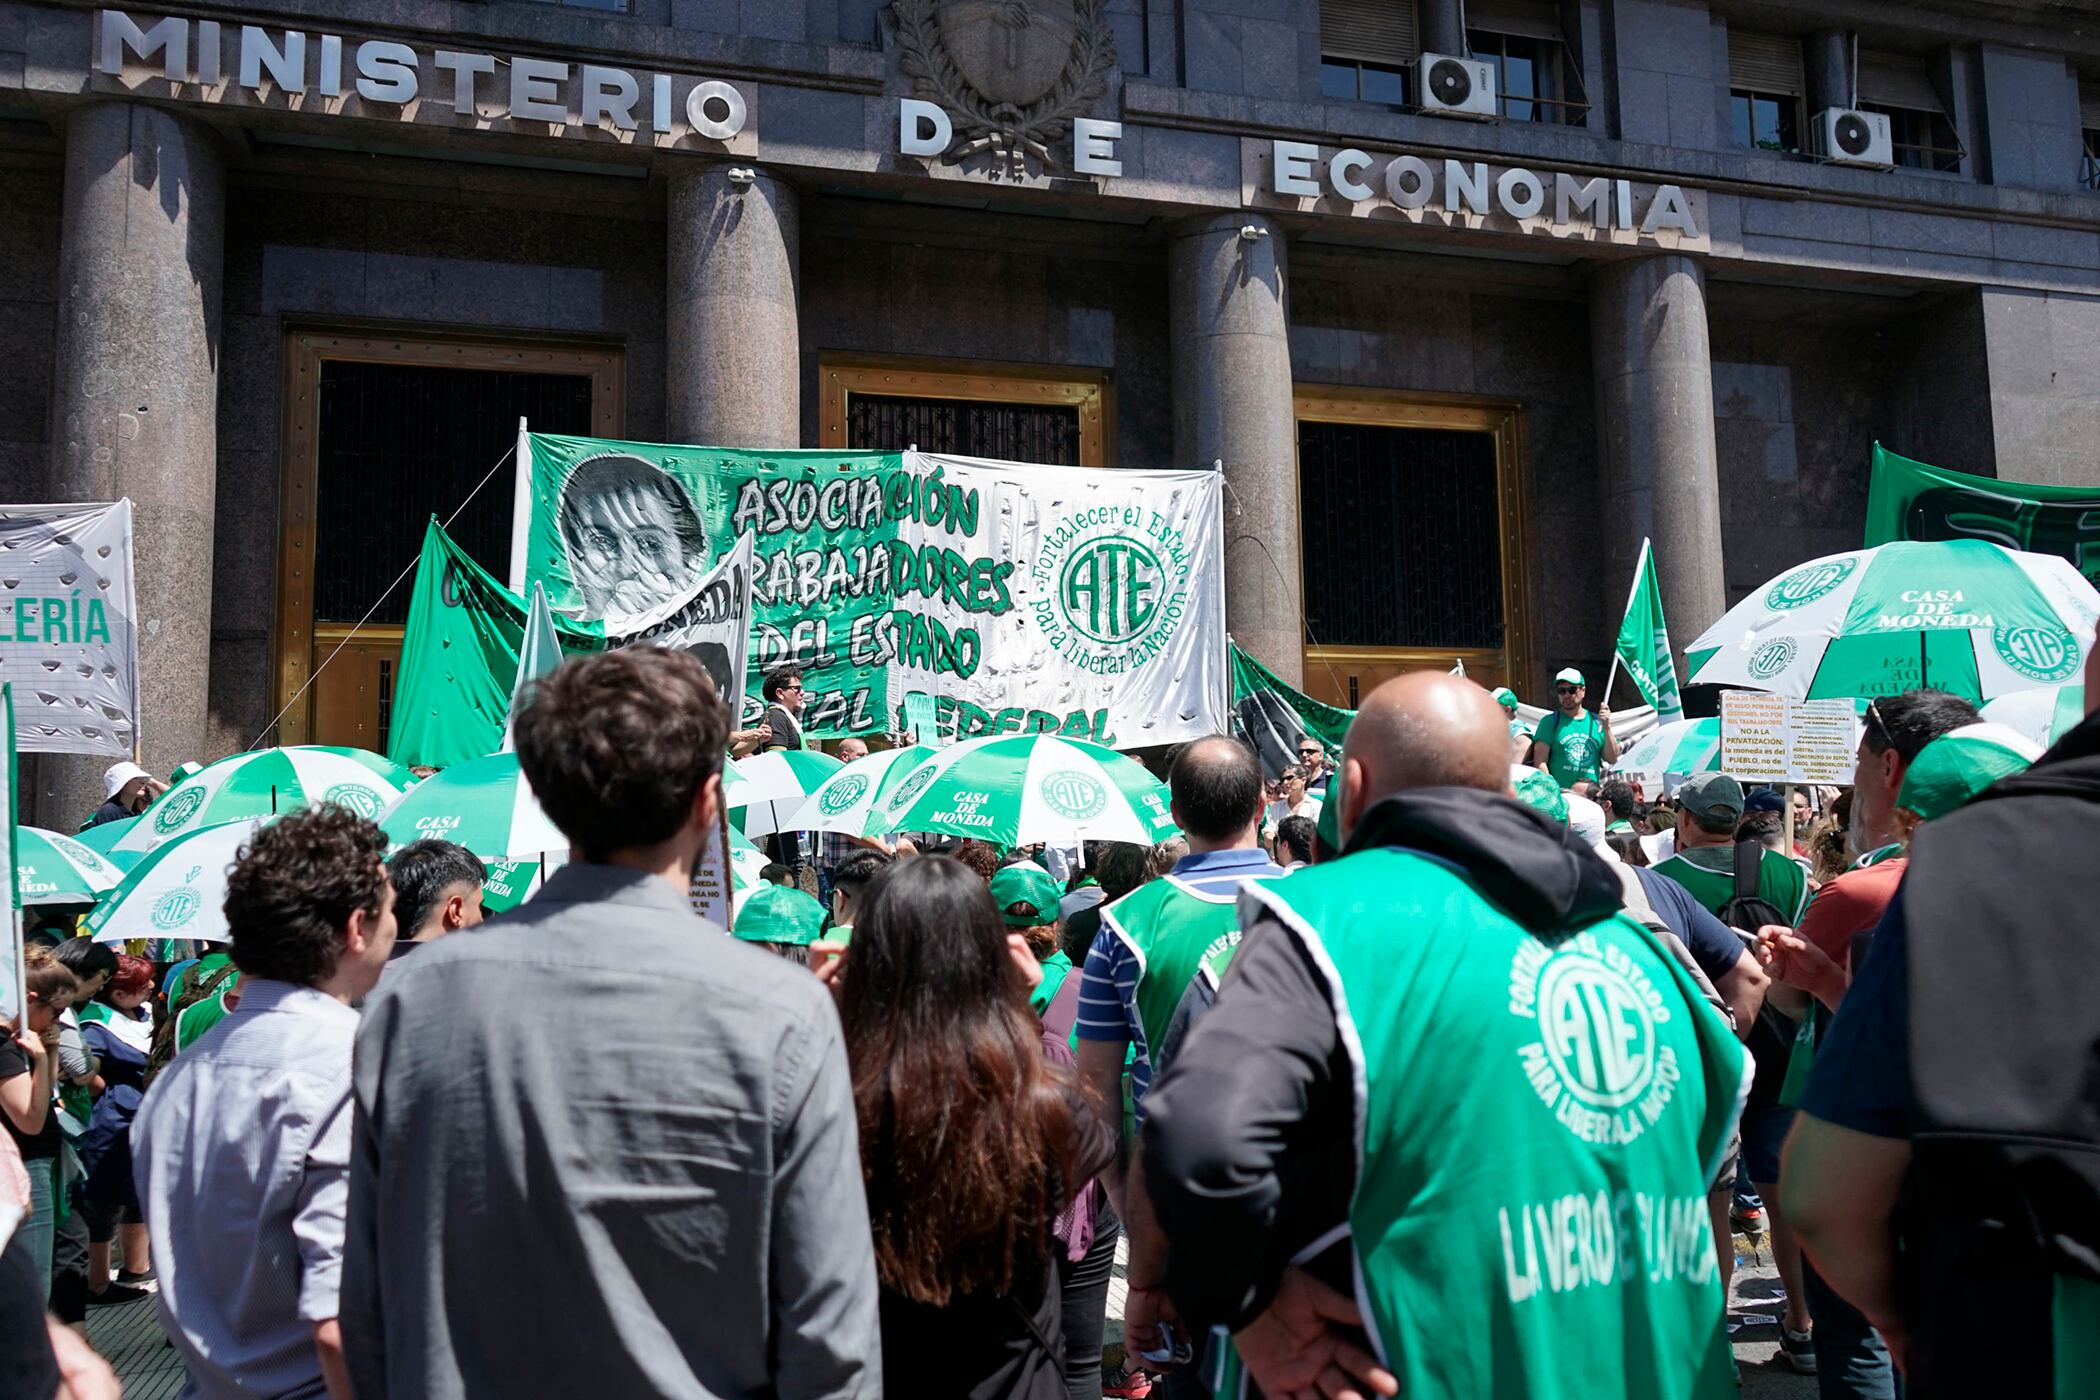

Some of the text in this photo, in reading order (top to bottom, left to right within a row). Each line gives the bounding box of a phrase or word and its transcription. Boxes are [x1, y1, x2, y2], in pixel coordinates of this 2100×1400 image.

[101, 9, 748, 140] MINISTERIO
[1273, 140, 1698, 238] ECONOMIA
[732, 466, 979, 537] ASOCIACIÓN
[1032, 506, 1190, 582] Fortalecer el Estado
[718, 538, 1014, 616] RABAJADORES
[1068, 543, 1156, 638] ATE
[1901, 590, 1964, 602] CASA
[1916, 602, 1955, 615] DE
[757, 608, 982, 680] DEL ESTADO
[1028, 597, 1067, 650] para
[1063, 638, 1127, 674] liberar
[1127, 643, 1148, 669] la
[1878, 614, 1995, 628] MONEDA
[897, 690, 1117, 748] EDERAL
[415, 816, 461, 830] CASA
[929, 810, 995, 827] MONEDA
[953, 791, 989, 804] CASA
[954, 802, 980, 814] DE
[490, 869, 509, 882] DE
[1555, 972, 1646, 1094] ATE
[1516, 1041, 1563, 1109] PARA
